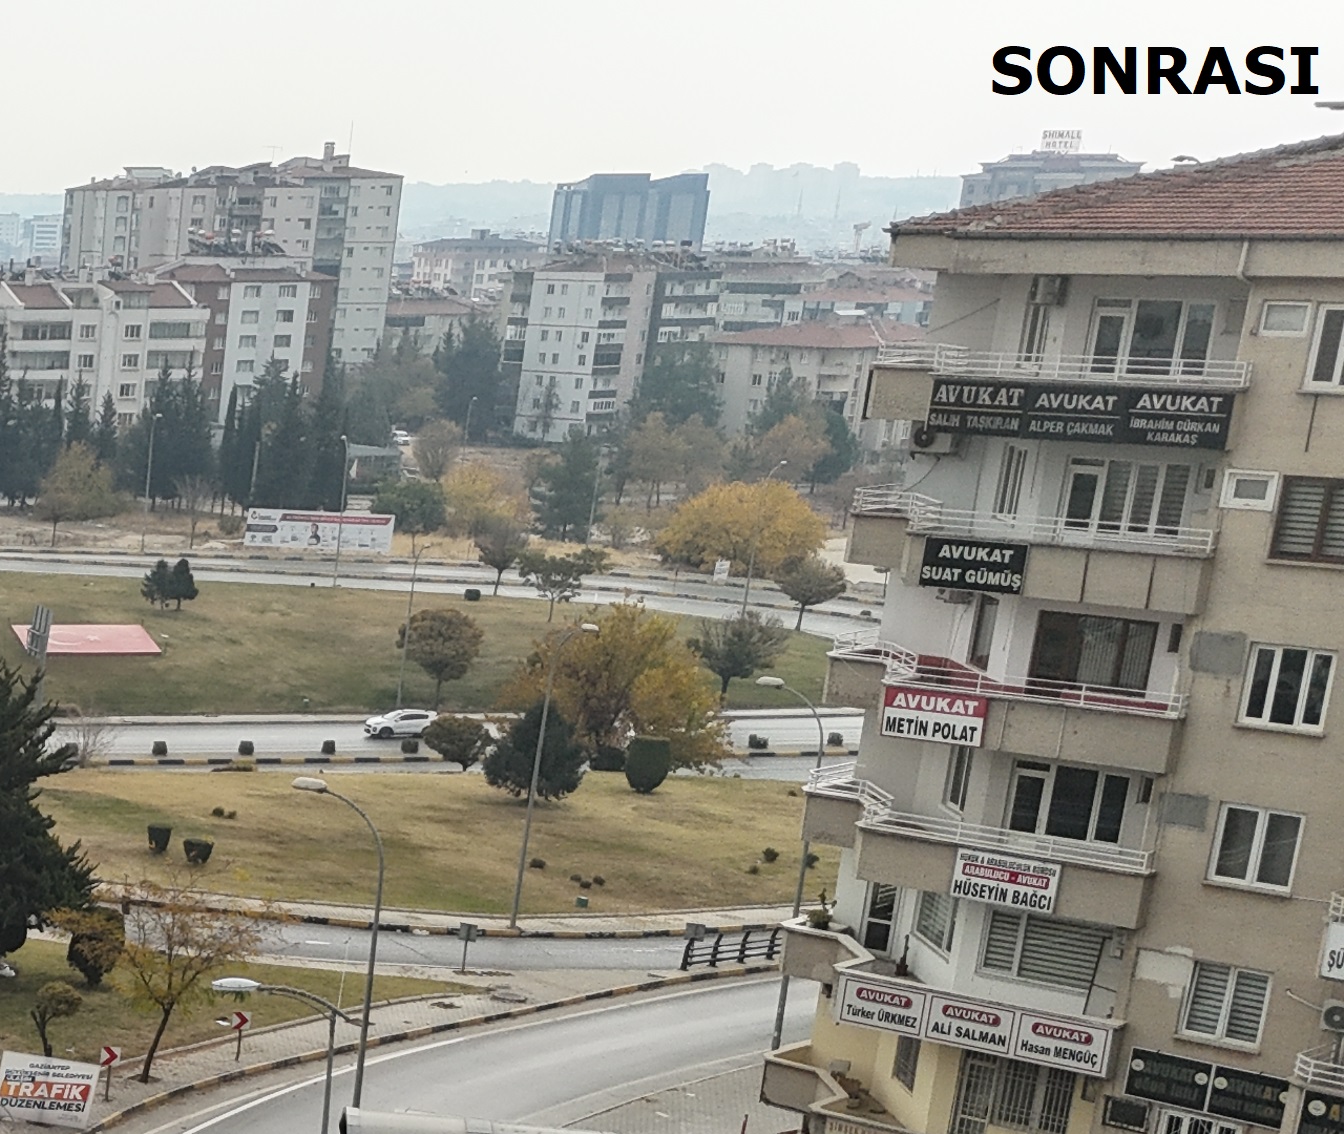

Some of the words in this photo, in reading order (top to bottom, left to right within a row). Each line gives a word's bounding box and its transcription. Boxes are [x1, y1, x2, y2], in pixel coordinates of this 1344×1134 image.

[934, 384, 1025, 406] AVUKAT
[1035, 393, 1118, 411] AVUKAT
[1136, 393, 1223, 412] AVUKAT
[1028, 419, 1063, 434] ALPER
[1067, 420, 1114, 436] ÇAKMAK
[1129, 416, 1175, 430] İBRAHİM
[1146, 431, 1198, 445] KARAKAŞ
[938, 544, 1014, 563] AVUKAT
[921, 565, 962, 581] SUAT
[964, 567, 1022, 591] GÜMÜŞ
[892, 692, 979, 715] AVUKAT
[885, 715, 929, 737] METİN
[931, 721, 978, 742] POLAT
[964, 864, 1010, 881] ARABULUCU
[1016, 874, 1048, 887] AVUKAT
[953, 878, 1008, 903] HÜSEYİN
[1011, 889, 1052, 910] BAĞCI
[859, 989, 908, 1006] AVUKAT
[846, 1004, 876, 1019] Türker
[877, 1009, 918, 1028] ÜRKMEZ
[945, 1006, 996, 1024] AVUKAT
[931, 1021, 952, 1035] ALİ
[955, 1026, 1007, 1047] SALMAN
[1036, 1025, 1089, 1042] AVUKAT
[1020, 1039, 1051, 1056] Hasan
[1053, 1046, 1098, 1068] MENGÜÇ
[7, 1081, 86, 1100] TRAFİK
